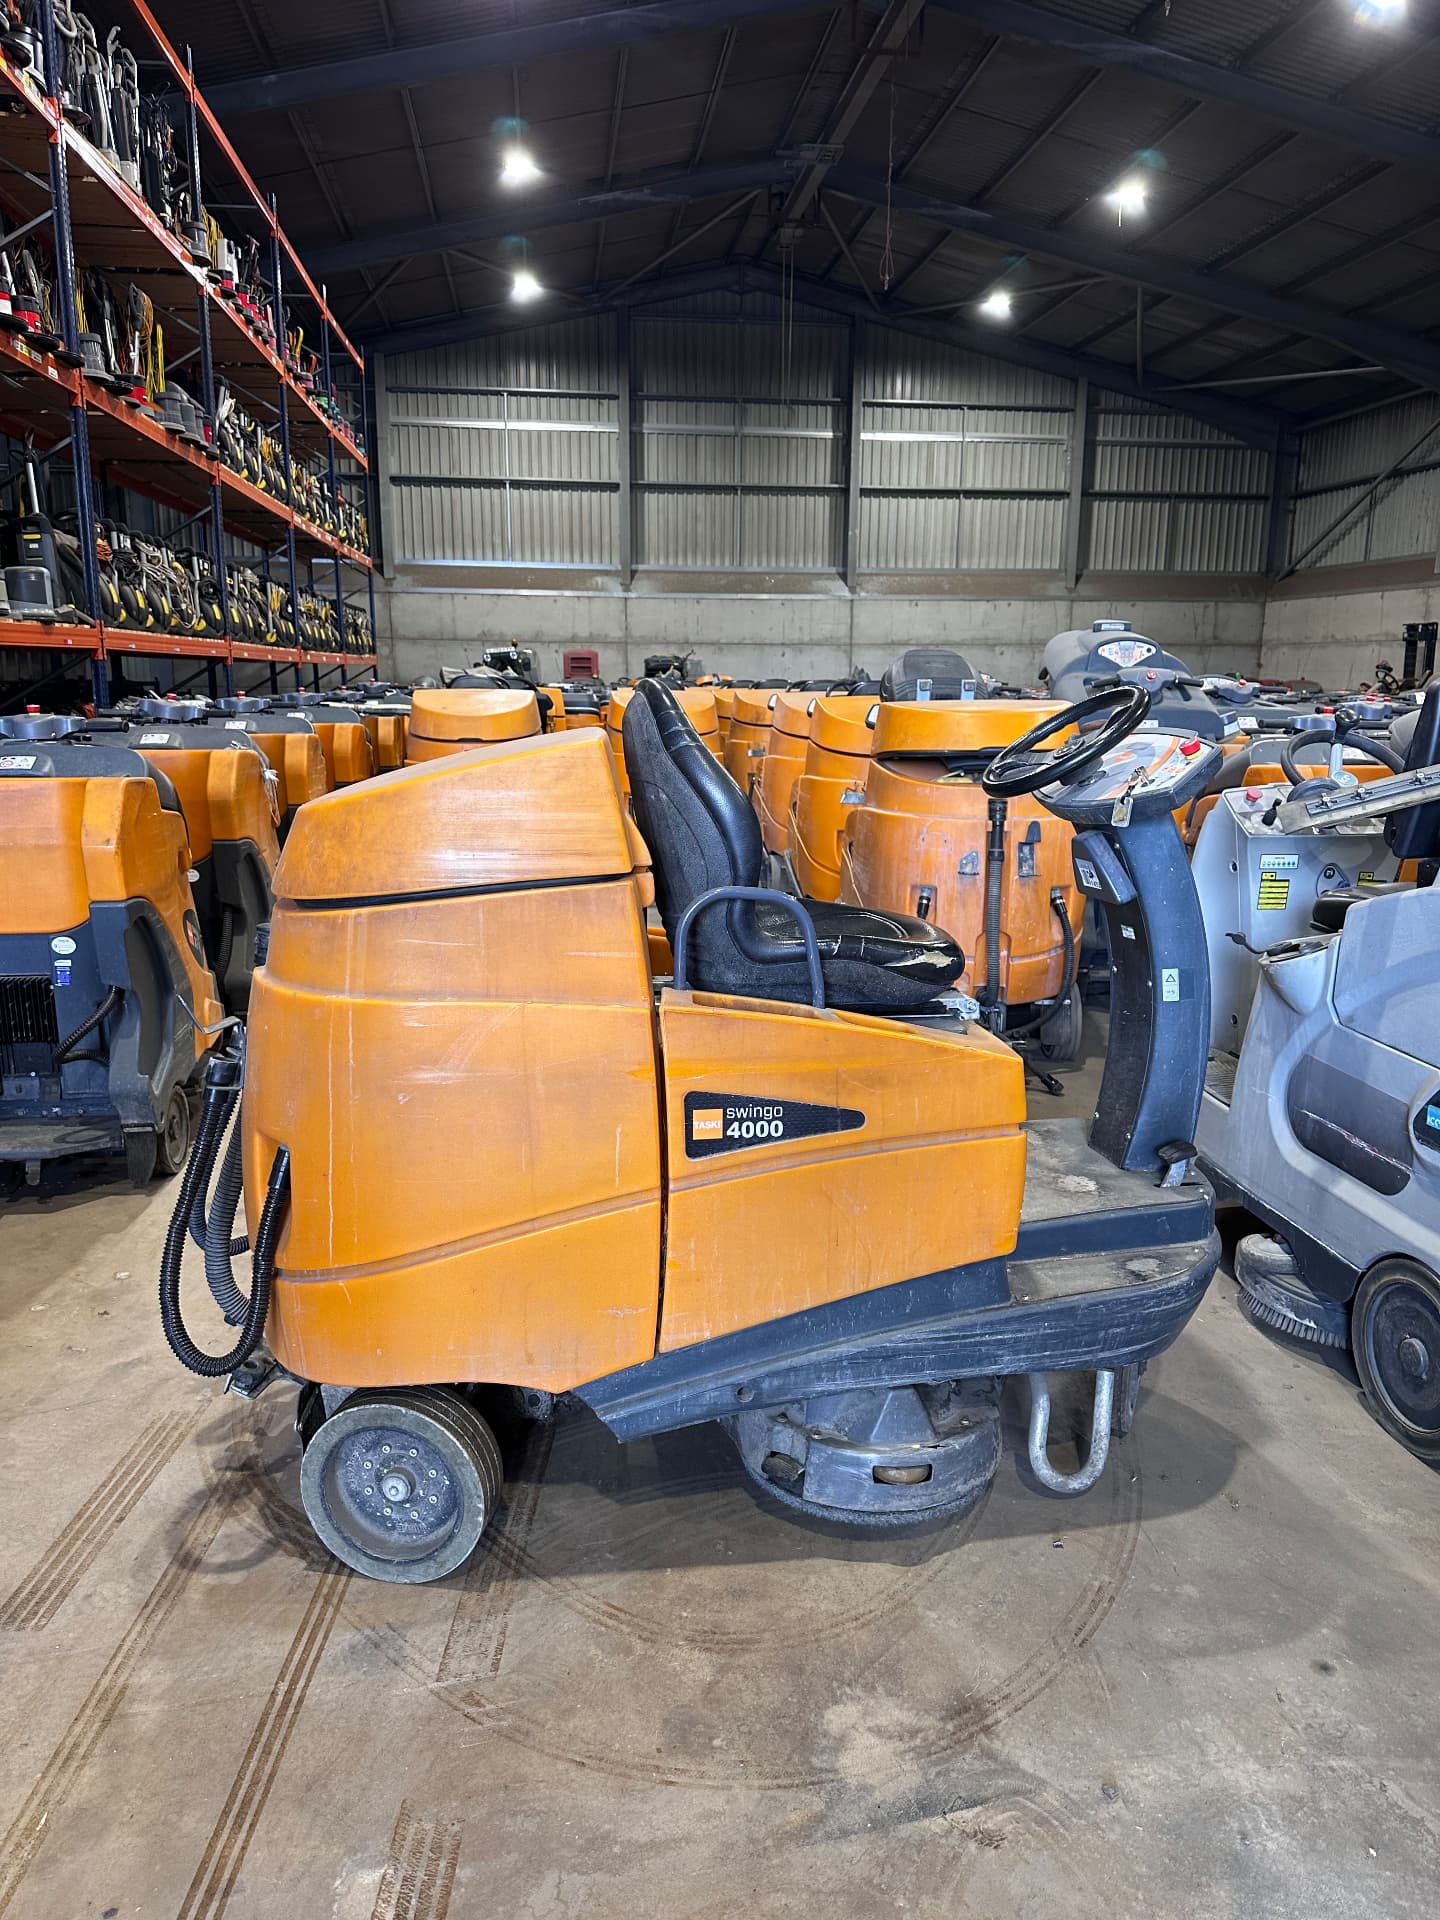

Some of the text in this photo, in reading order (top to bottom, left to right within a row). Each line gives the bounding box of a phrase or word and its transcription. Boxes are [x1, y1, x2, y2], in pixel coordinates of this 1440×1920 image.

[726, 1104, 783, 1120] swingo
[694, 1120, 721, 1129] TASKI
[726, 1120, 784, 1139] 4000
